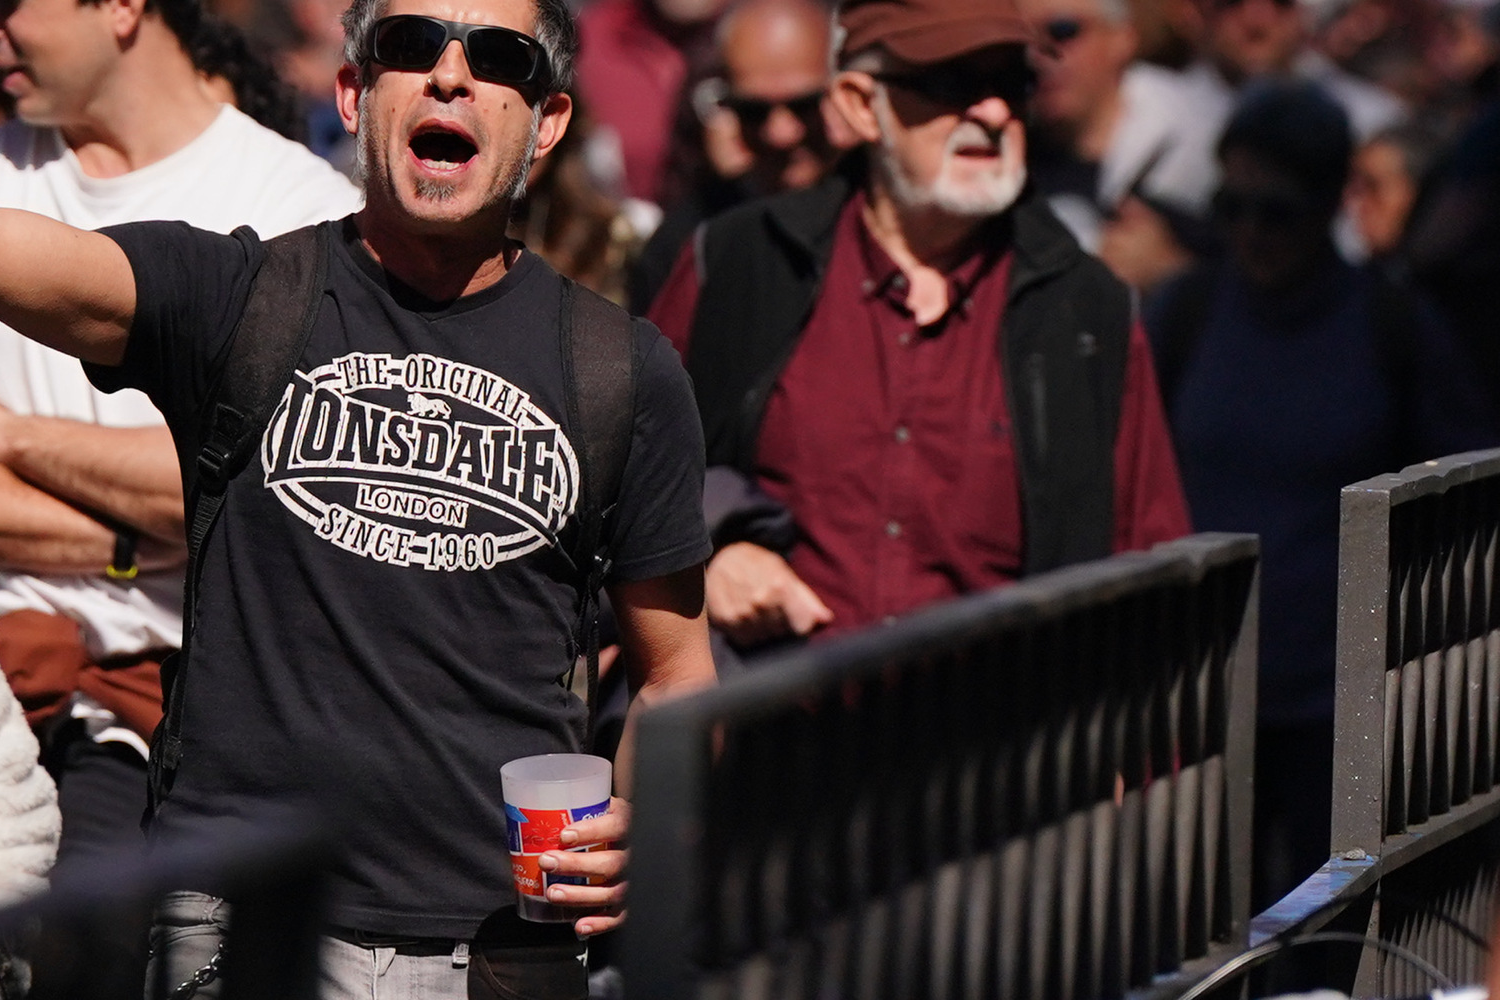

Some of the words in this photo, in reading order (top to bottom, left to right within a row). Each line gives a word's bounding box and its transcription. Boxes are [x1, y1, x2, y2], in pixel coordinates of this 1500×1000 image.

[336, 357, 389, 391] THE
[404, 358, 527, 422] ORIGINAL
[268, 375, 558, 520] LONSDALE
[359, 486, 466, 526] LONDON
[322, 508, 410, 565] SINCE
[429, 535, 495, 568] 1960
